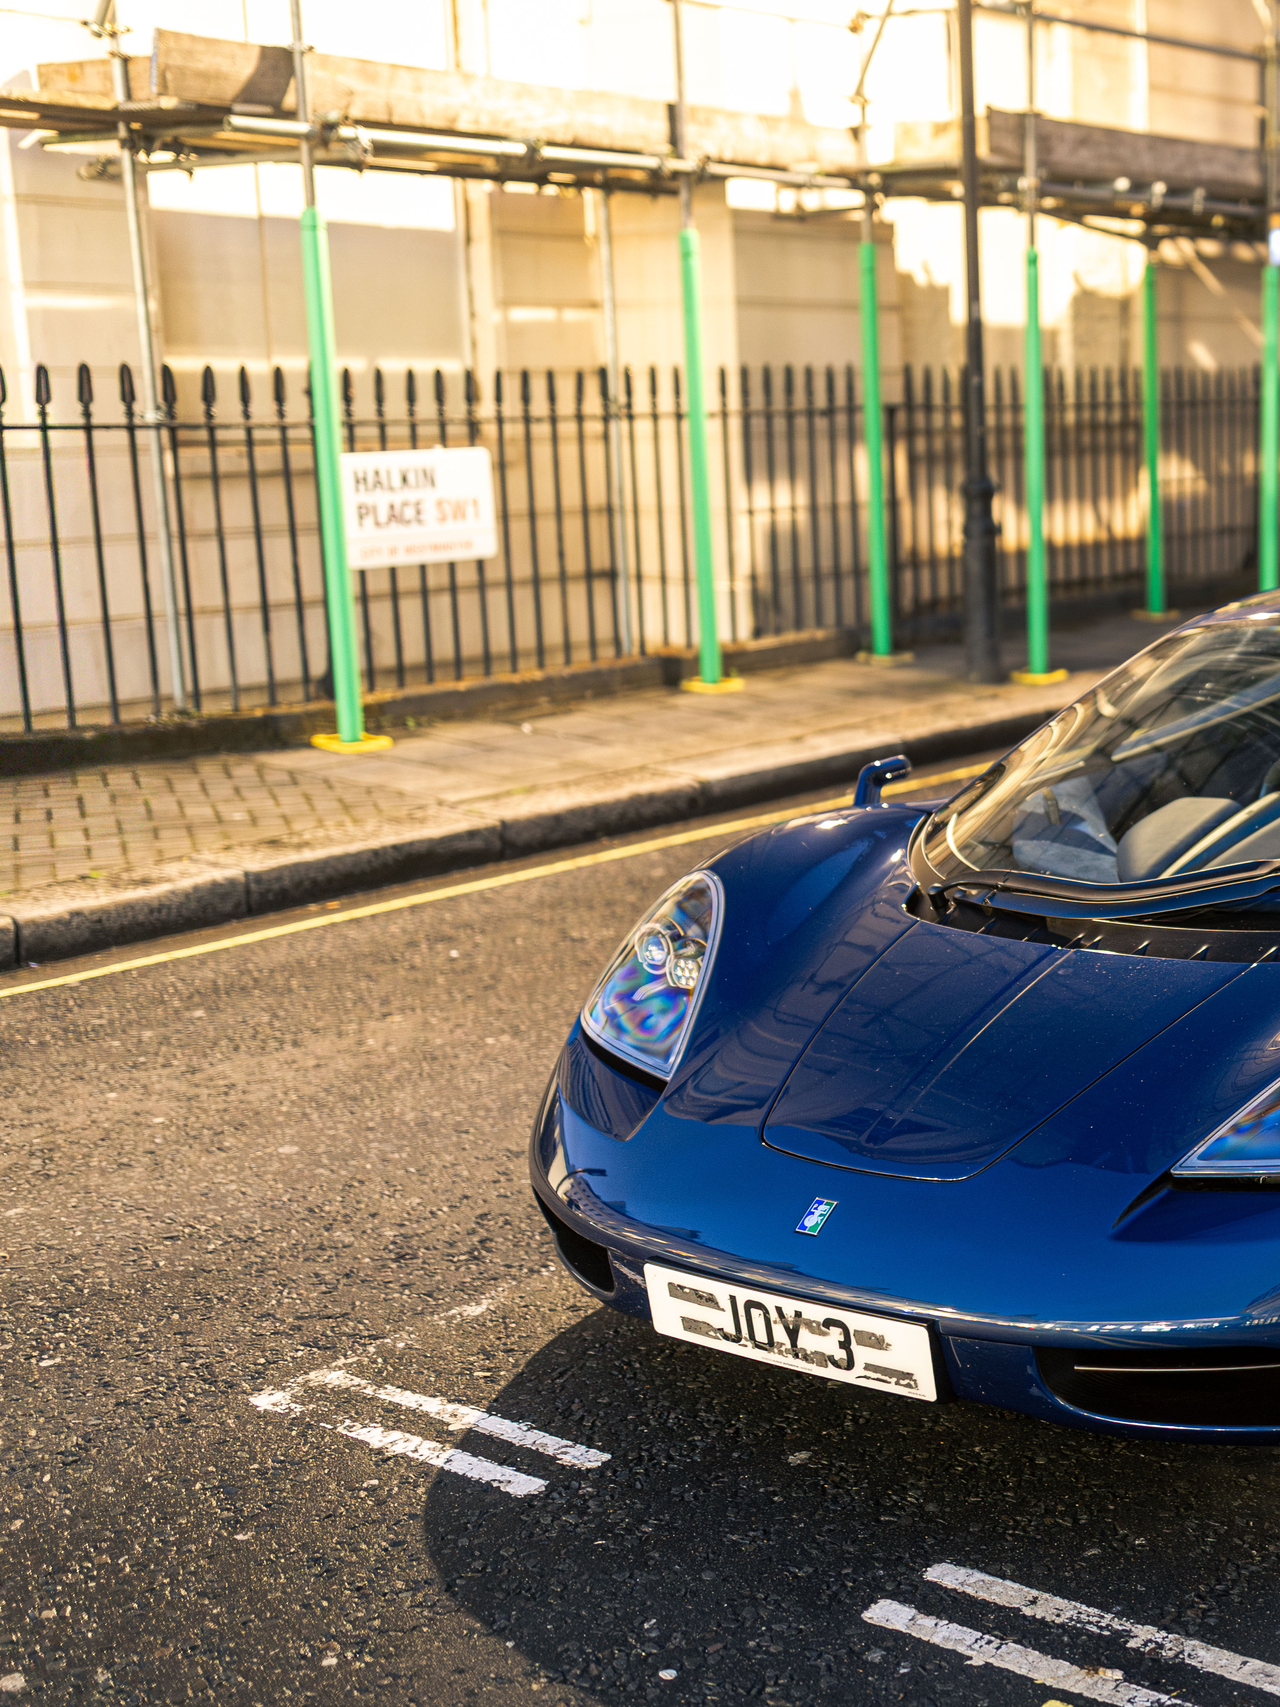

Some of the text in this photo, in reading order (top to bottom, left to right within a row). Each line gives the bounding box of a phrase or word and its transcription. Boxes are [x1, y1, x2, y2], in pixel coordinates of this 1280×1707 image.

[354, 467, 436, 493] HALKIN
[357, 498, 481, 528] PLACE SW1
[716, 1294, 855, 1371] JOY 3
